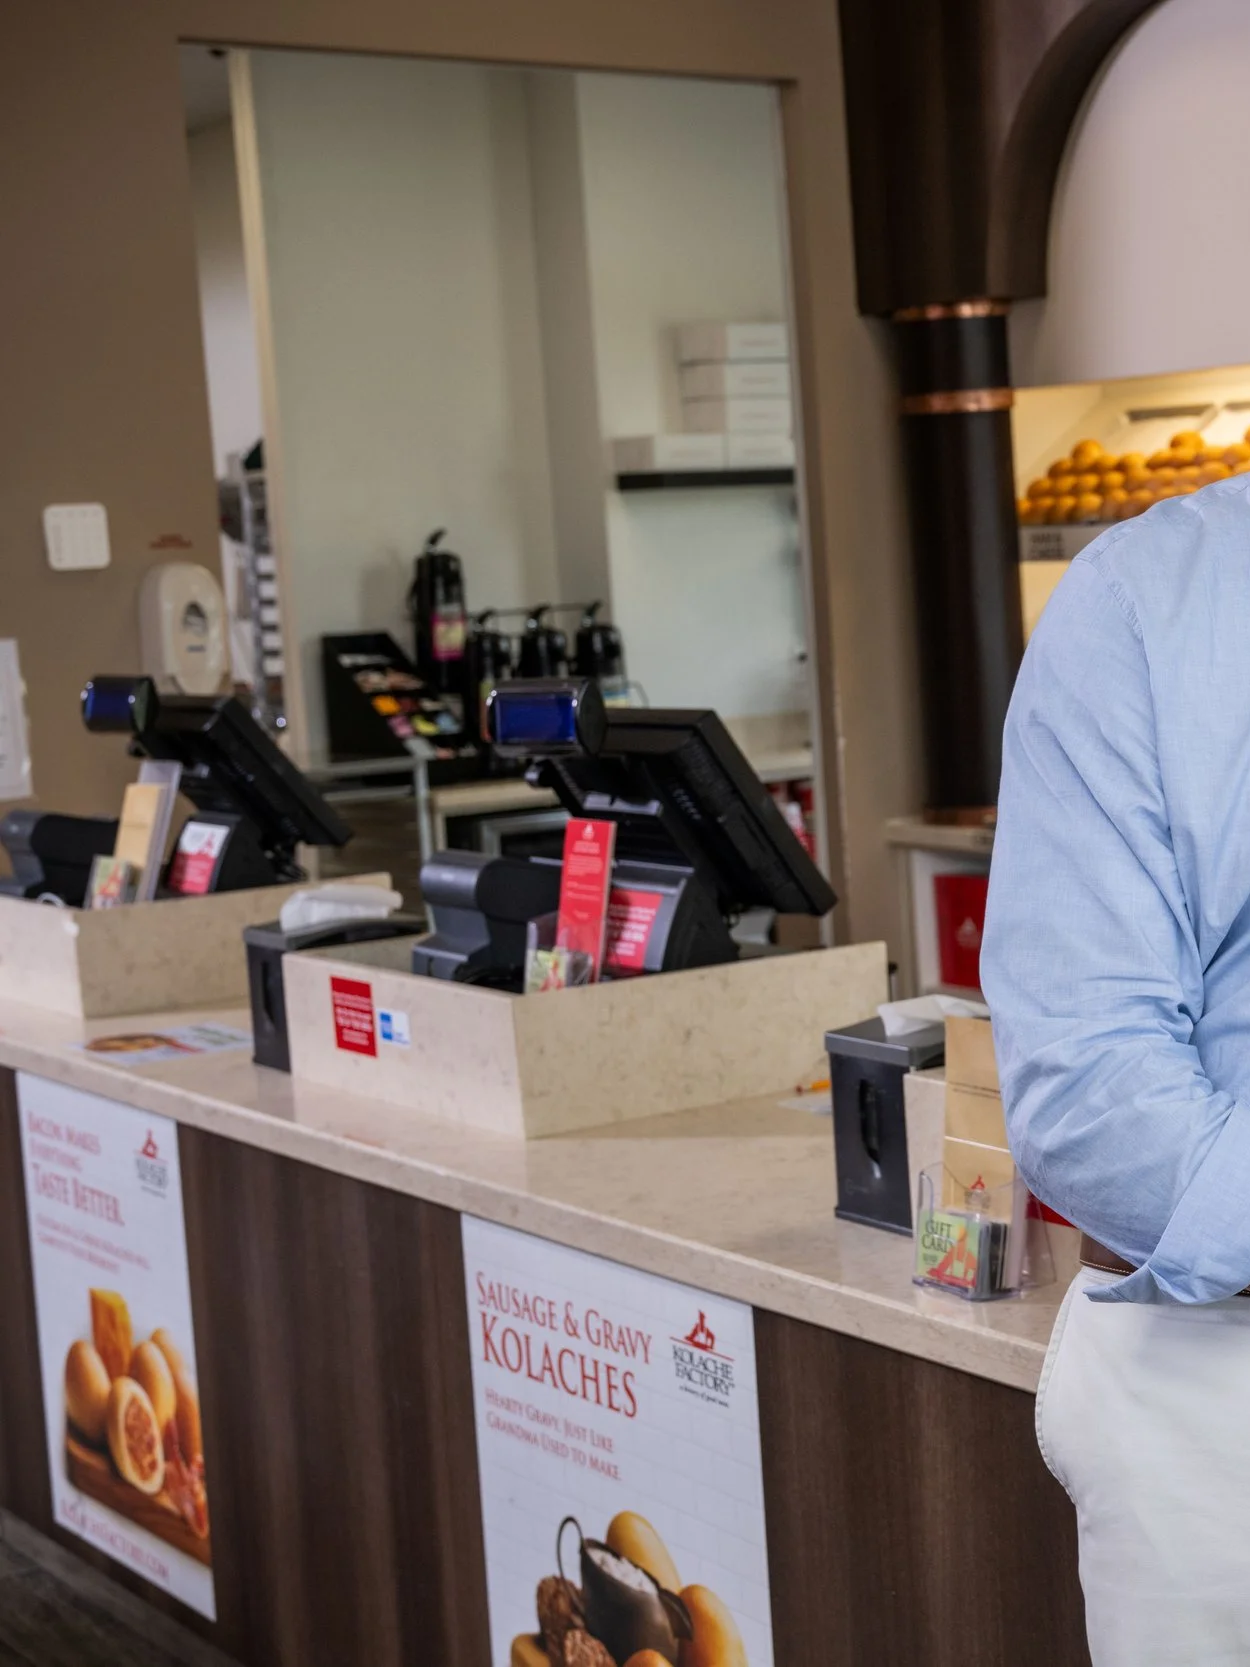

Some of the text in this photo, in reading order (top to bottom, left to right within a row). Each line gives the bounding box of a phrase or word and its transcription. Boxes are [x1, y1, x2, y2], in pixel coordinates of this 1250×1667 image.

[925, 1219, 952, 1238] GIFT
[476, 1271, 652, 1364] SAUSAGE & GRAVY
[481, 1311, 637, 1419] KOLACHES
[672, 1344, 733, 1382] KOLACHE
